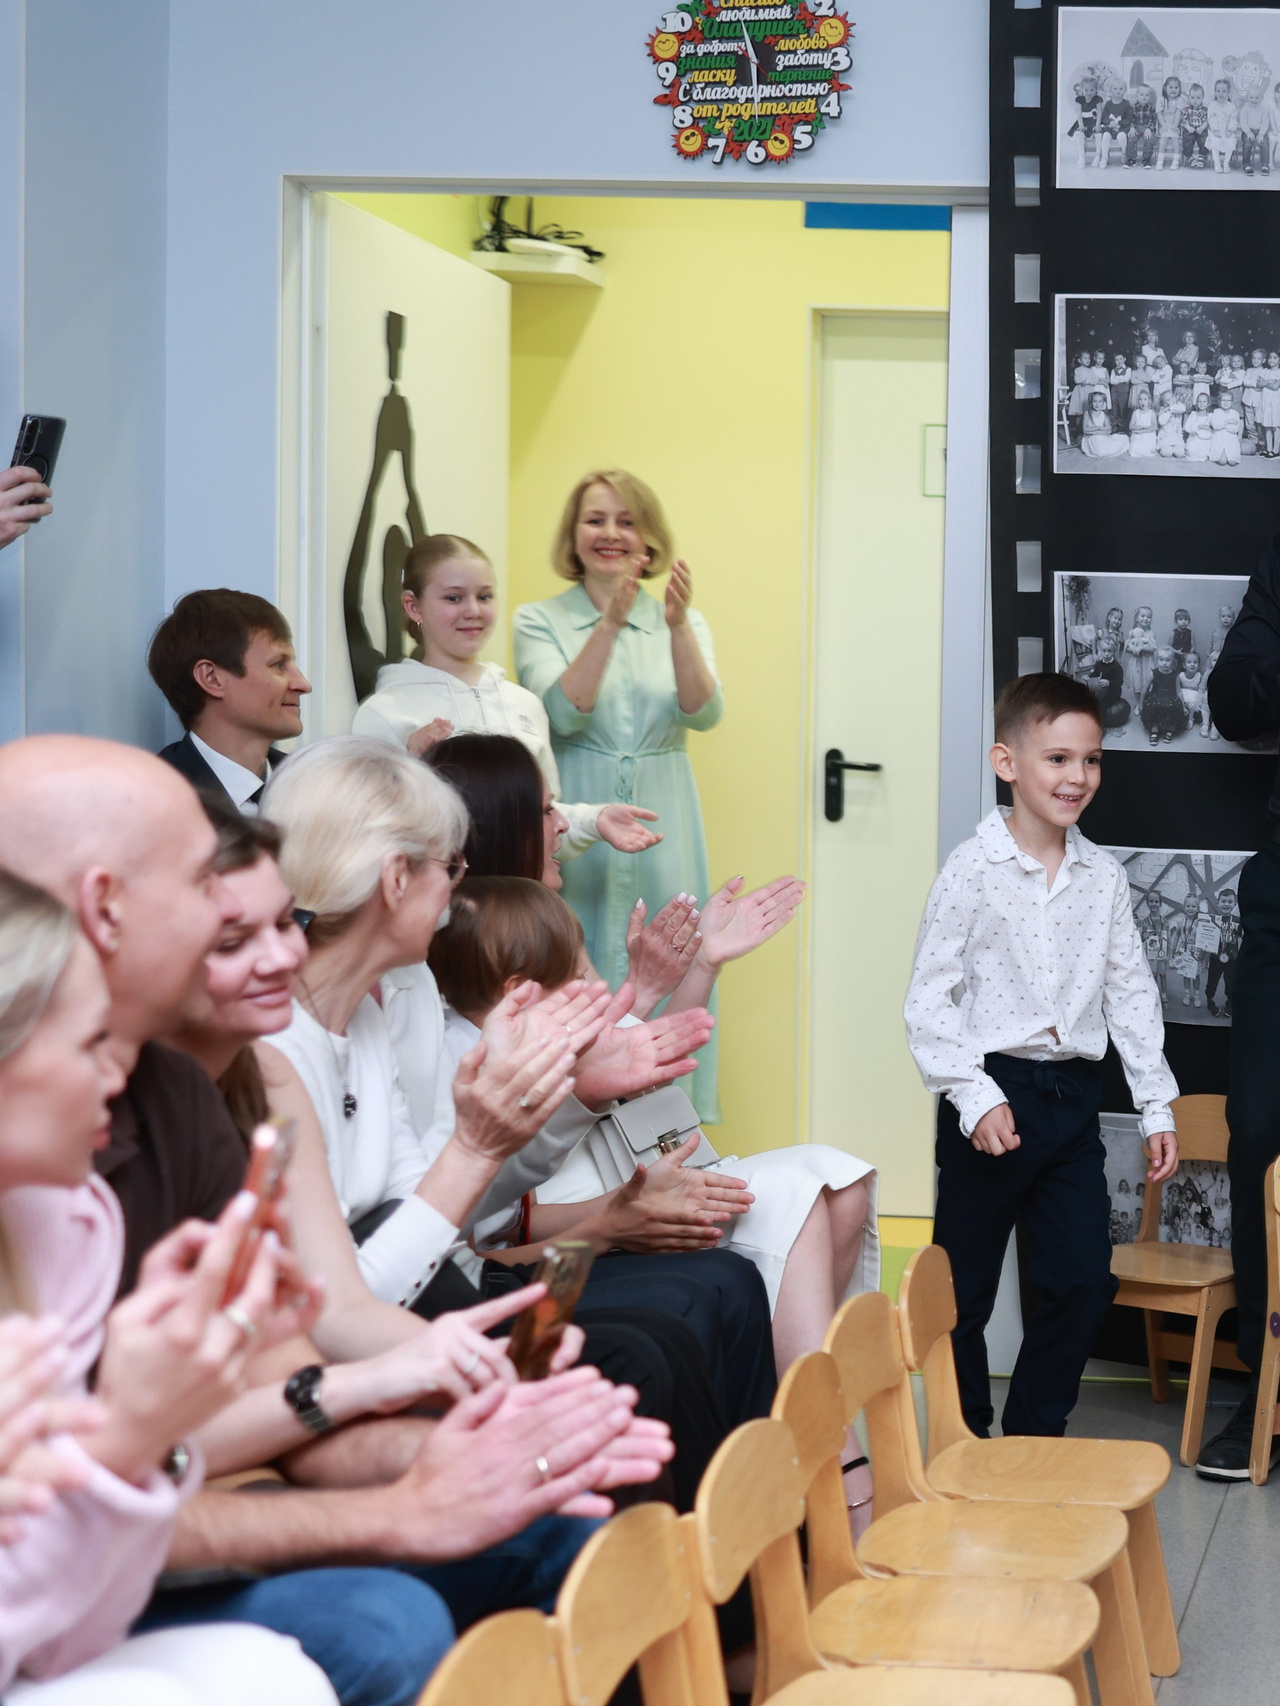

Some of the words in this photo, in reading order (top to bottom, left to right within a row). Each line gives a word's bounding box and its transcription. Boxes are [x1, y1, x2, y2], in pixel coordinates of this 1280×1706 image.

[716, 4, 793, 22] любимый
[814, 0, 835, 17] 2
[662, 11, 693, 33] 10
[680, 43, 696, 57] за
[697, 40, 746, 57] доброту
[774, 33, 829, 51] любовь
[677, 54, 737, 76] знания
[775, 48, 834, 71] заботу
[830, 46, 851, 71] 3
[657, 61, 677, 86] 9
[688, 69, 737, 87] ласку
[767, 69, 834, 83] терпение
[678, 83, 690, 102] С
[692, 82, 832, 104] благодарностью
[820, 92, 840, 117] 4
[673, 105, 694, 128] 8
[693, 104, 720, 118] от
[721, 97, 818, 121] родителей
[733, 117, 774, 141] 2021
[793, 124, 813, 149] 5
[707, 138, 727, 163] 7
[746, 140, 766, 164] 6
